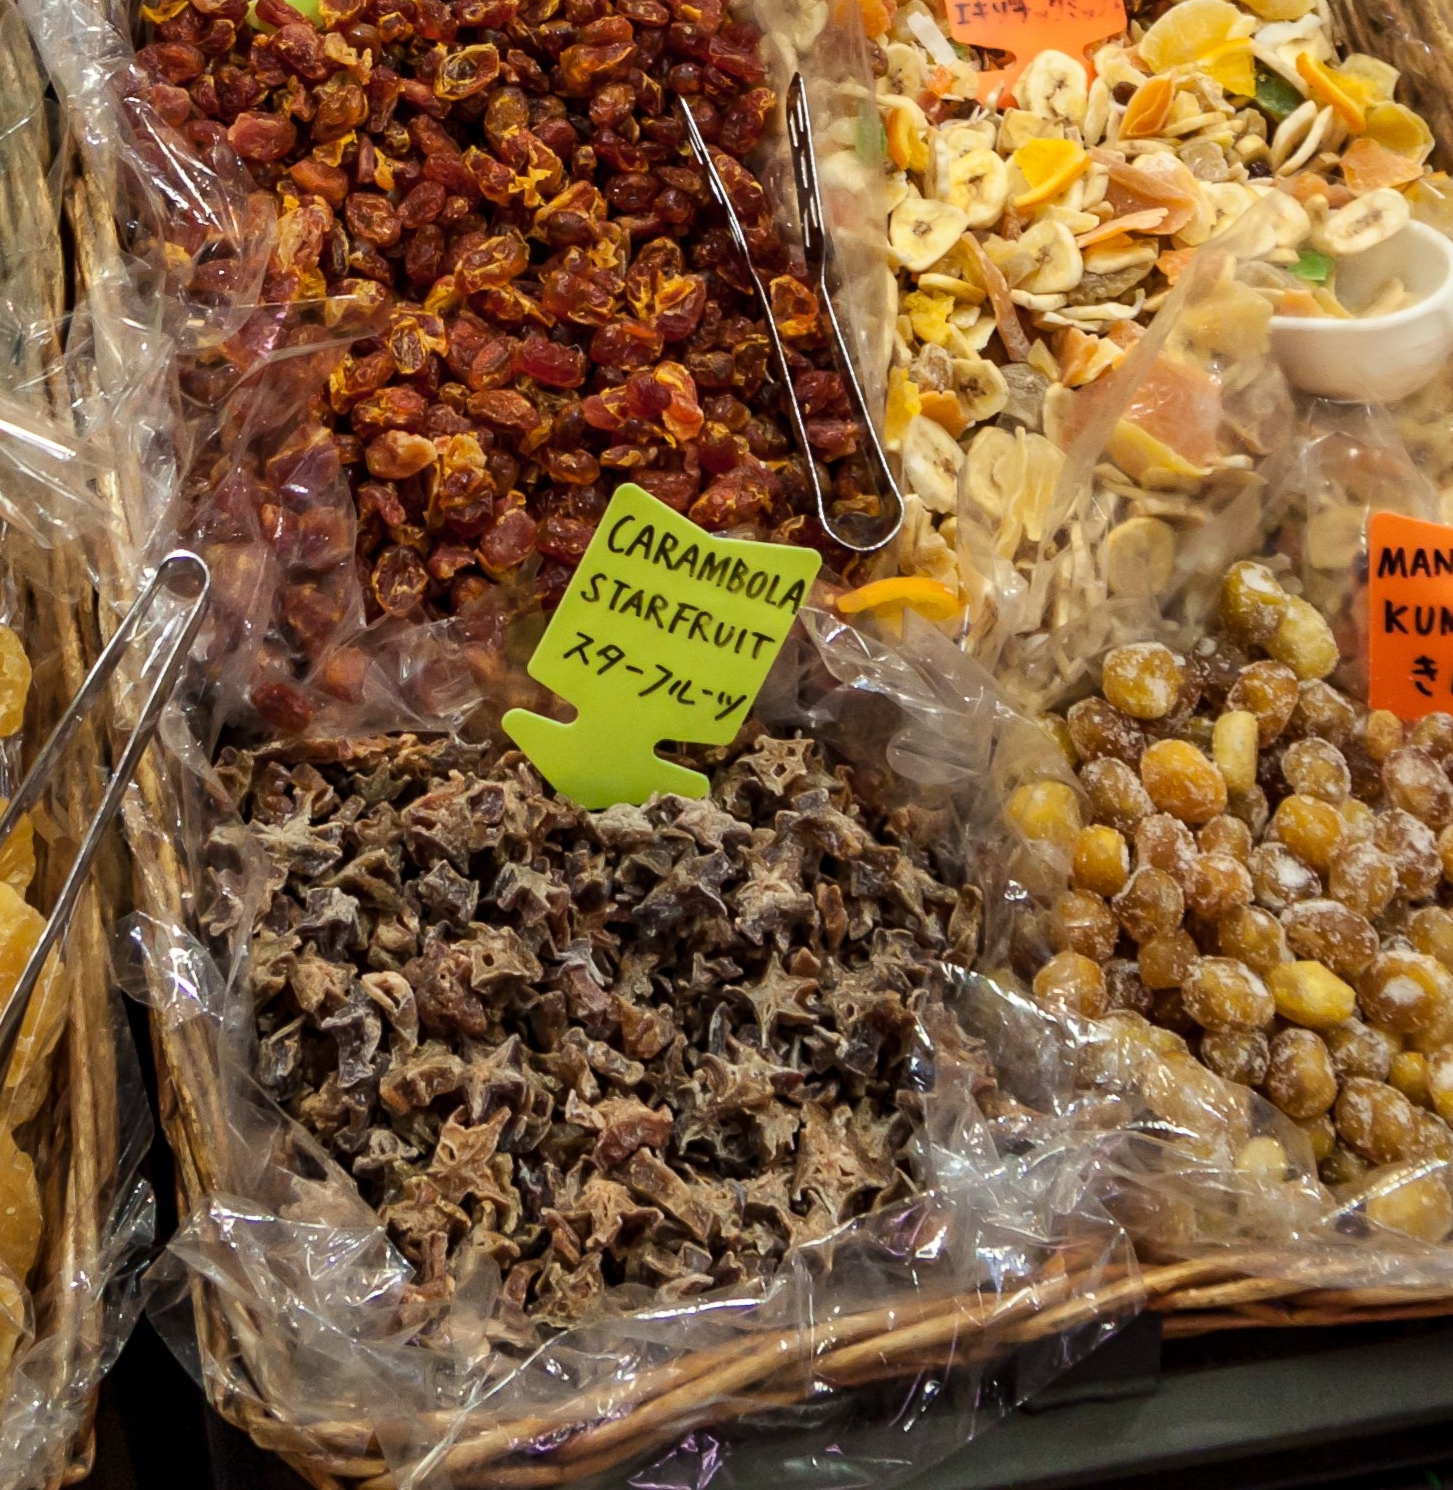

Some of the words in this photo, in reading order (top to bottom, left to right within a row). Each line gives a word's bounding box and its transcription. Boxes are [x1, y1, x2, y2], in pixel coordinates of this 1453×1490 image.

[607, 514, 806, 615] CARAMBOLA
[580, 572, 775, 659] STARFRUIT
[562, 631, 747, 721] スターフルーツ
